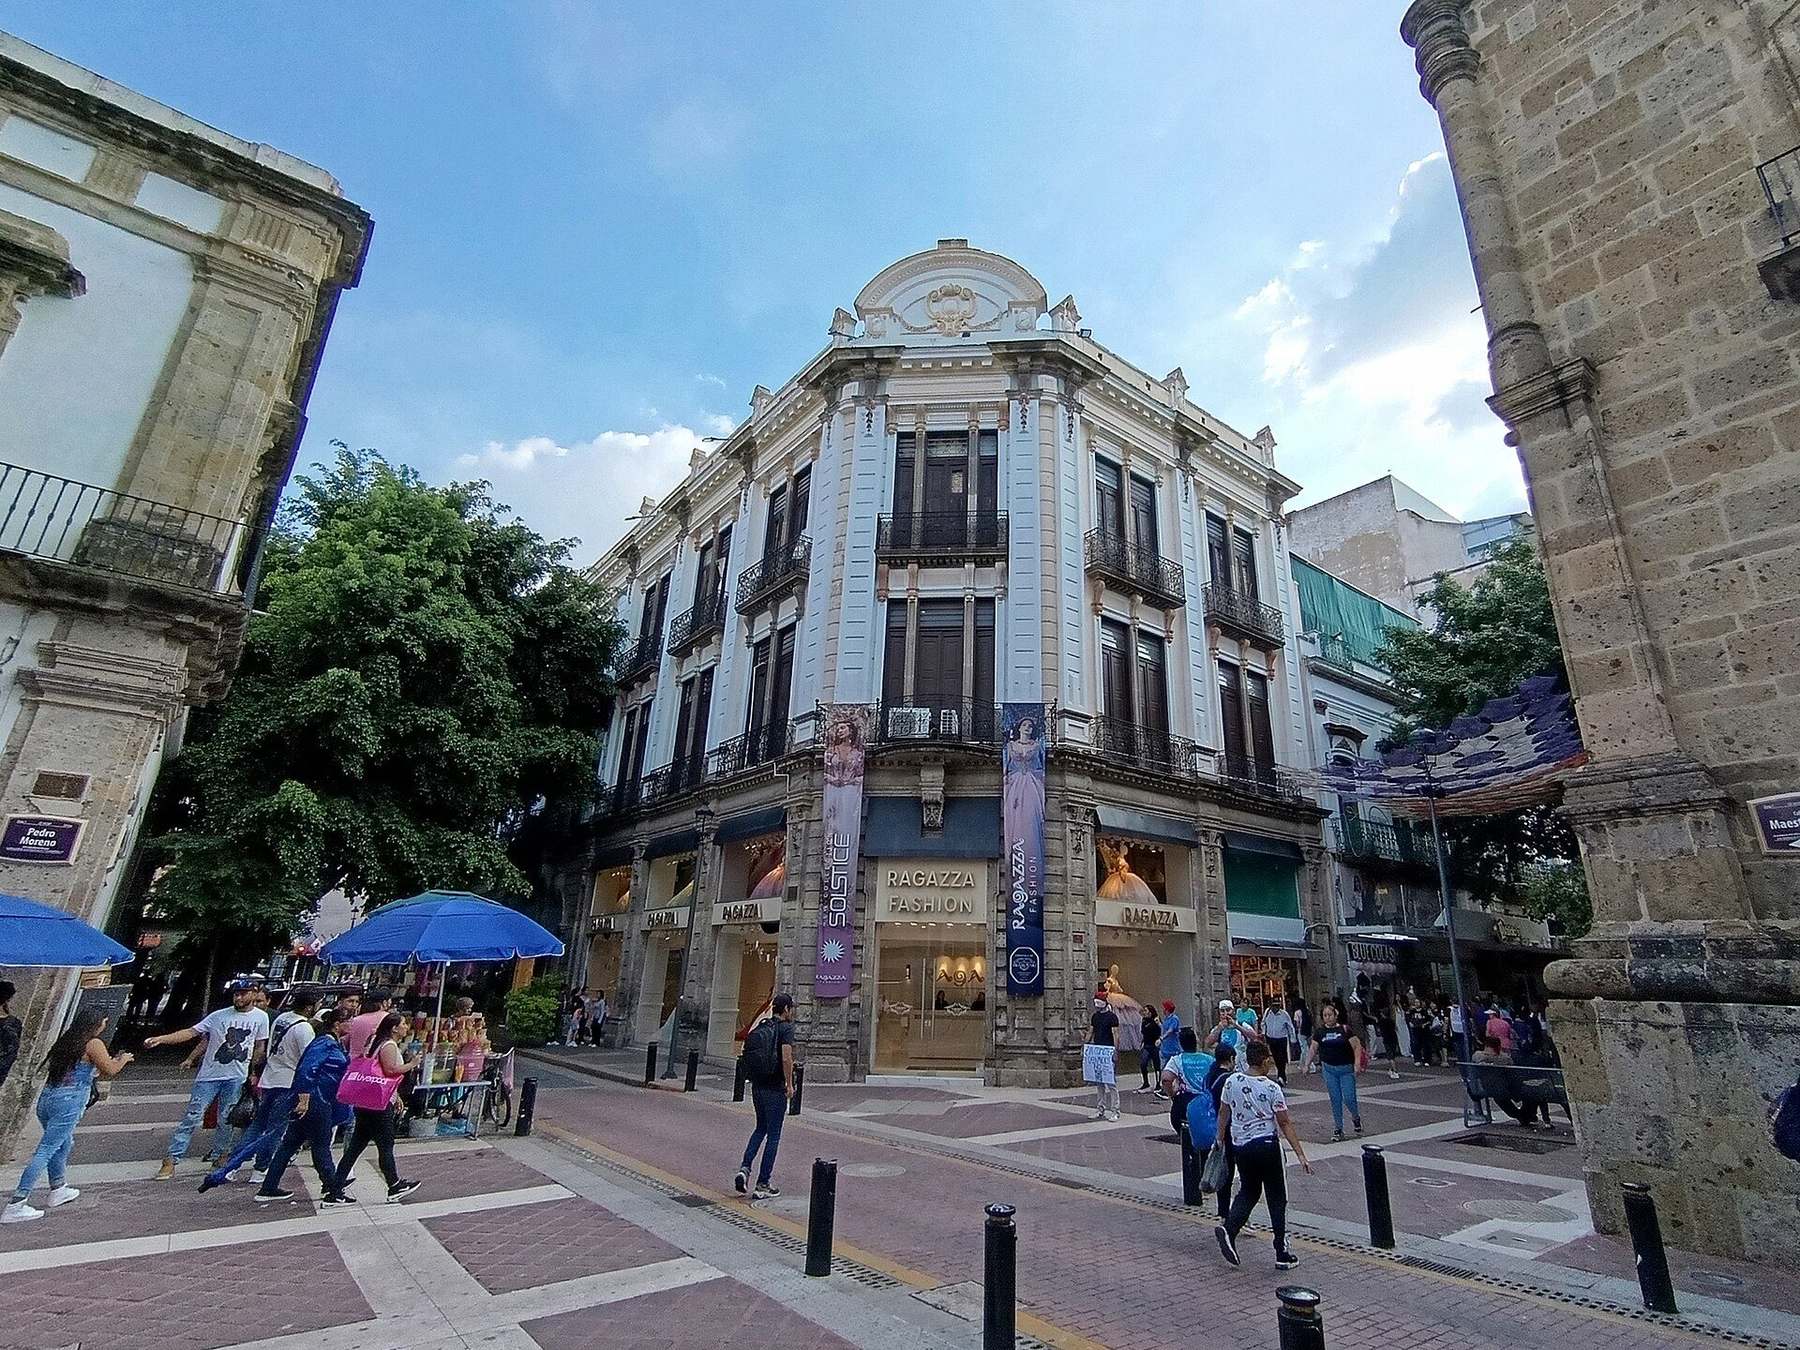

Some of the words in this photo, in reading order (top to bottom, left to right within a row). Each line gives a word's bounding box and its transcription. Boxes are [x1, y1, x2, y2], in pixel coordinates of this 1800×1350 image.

[19, 836, 57, 847] Moreno
[26, 827, 56, 838] Pedro
[828, 833, 850, 927] SOLSTICE
[887, 870, 975, 888] RAGAZZA
[1012, 837, 1029, 931] RAGAZZA
[1028, 855, 1038, 914] FASHION
[888, 896, 973, 913] FASHION
[1121, 906, 1180, 927] RAGAZZA
